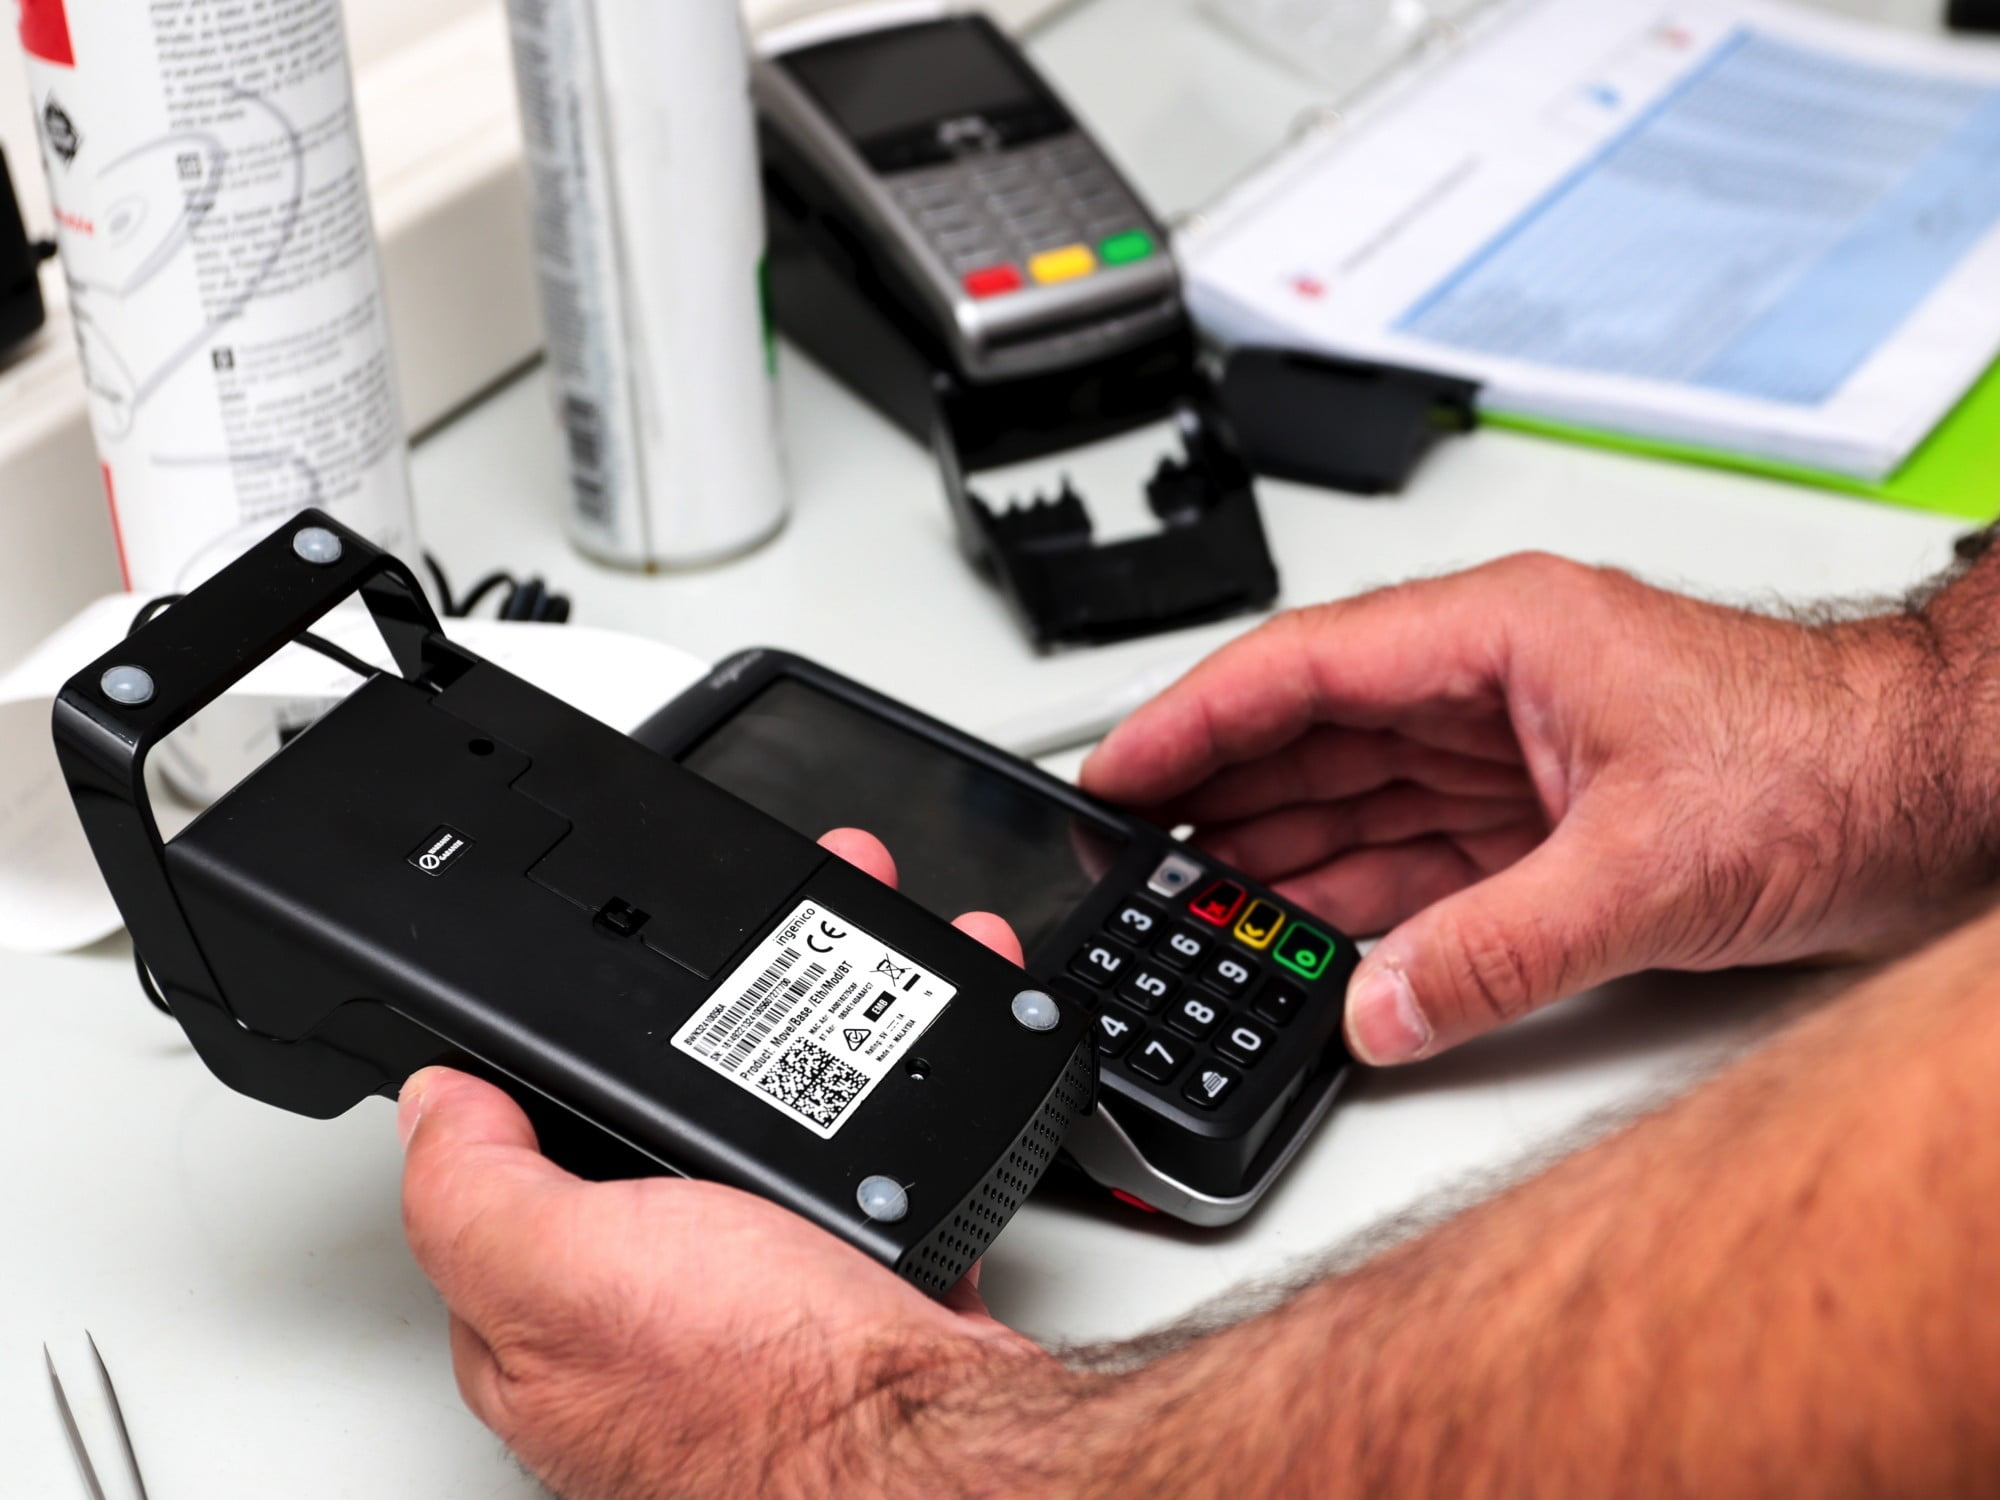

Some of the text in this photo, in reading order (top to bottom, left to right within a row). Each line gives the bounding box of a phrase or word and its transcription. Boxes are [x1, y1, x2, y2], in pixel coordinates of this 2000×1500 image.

[773, 908, 816, 947] ingenico
[1122, 908, 1152, 931] 3
[1170, 934, 1200, 956] 6
[1089, 948, 1121, 972] 2
[1218, 960, 1248, 983] 9
[1135, 973, 1166, 996] 5
[1184, 1000, 1215, 1024] 8
[1100, 1015, 1129, 1037] 4
[739, 1047, 776, 1082] Product:
[769, 1006, 813, 1048] Move/Base
[1231, 1027, 1261, 1051] 0
[1145, 1040, 1174, 1065] 7
